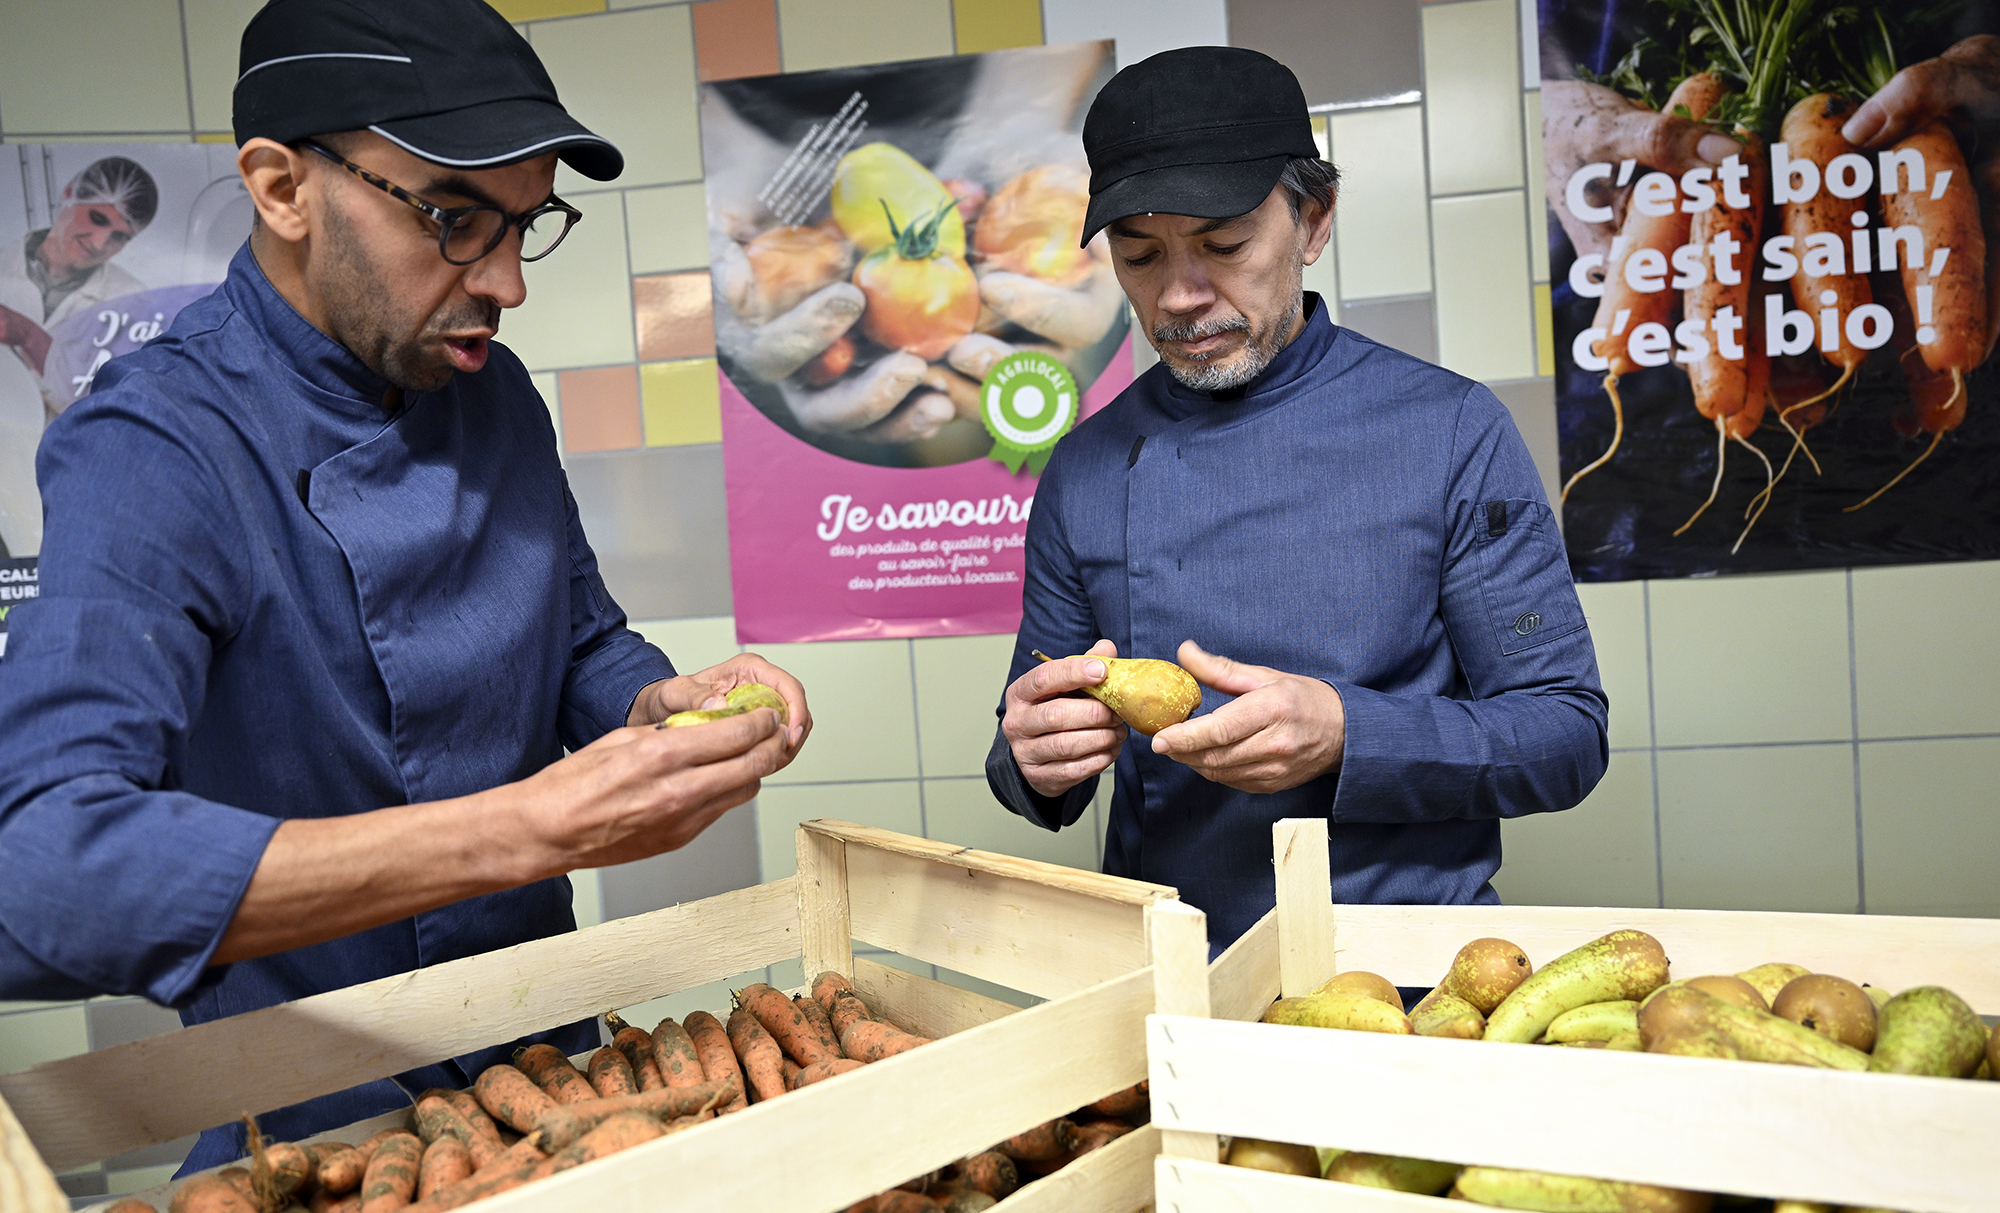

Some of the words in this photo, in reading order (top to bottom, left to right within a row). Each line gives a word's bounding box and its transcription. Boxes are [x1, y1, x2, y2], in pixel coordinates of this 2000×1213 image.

[1566, 154, 1751, 223] C'est
[1770, 142, 1953, 206] bon,
[1569, 229, 1741, 298] c'est
[1761, 210, 1951, 282] sain,
[1572, 304, 1744, 371] c'est
[1765, 289, 1894, 357] bio
[996, 359, 1067, 392] AGRILOCAL
[817, 494, 873, 541] Je
[829, 543, 855, 557] des
[855, 540, 918, 559] produits
[919, 538, 938, 553] de
[940, 535, 991, 556] qualité
[877, 559, 898, 572] au
[900, 553, 989, 573] savoir-faire
[848, 576, 874, 590] des
[874, 572, 963, 592] producteurs
[964, 570, 1019, 585] locaux.
